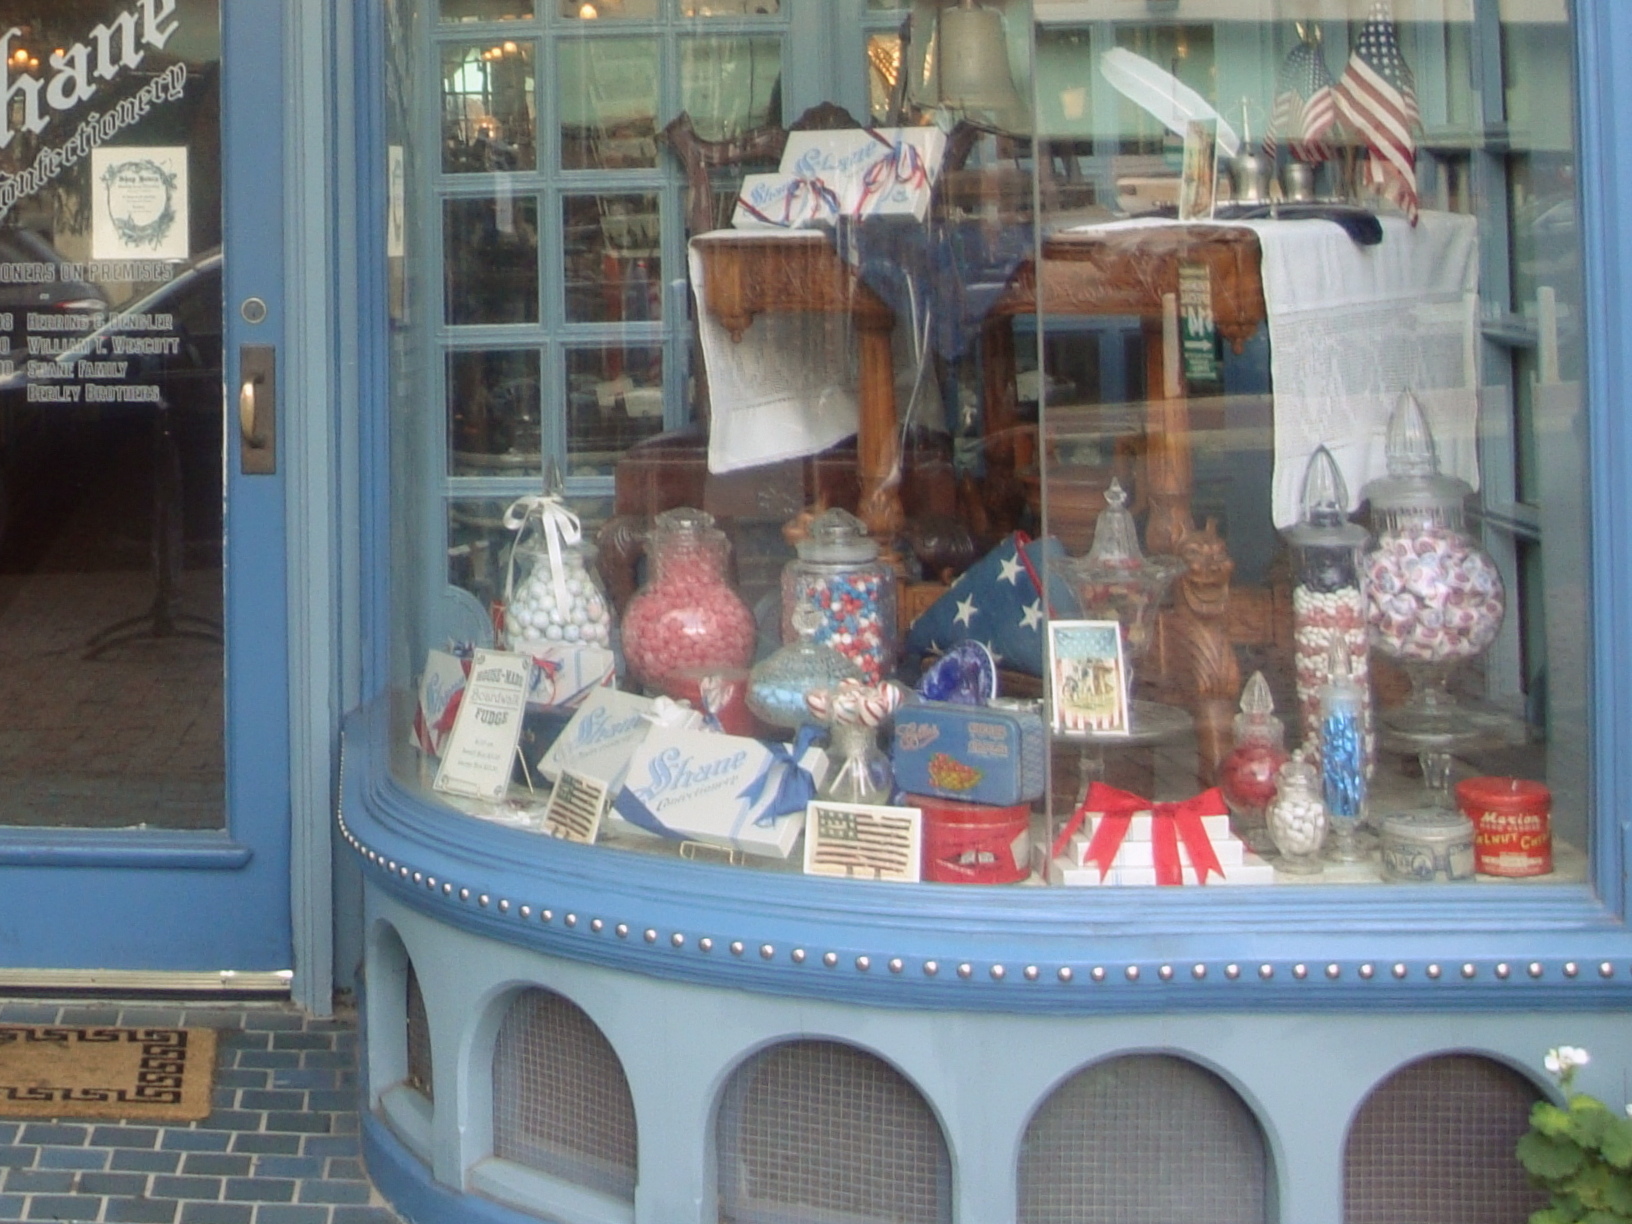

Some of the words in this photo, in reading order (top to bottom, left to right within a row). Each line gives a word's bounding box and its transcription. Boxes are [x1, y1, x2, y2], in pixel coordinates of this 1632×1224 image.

[60, 262, 84, 283] ON
[89, 261, 175, 283] PREMISES
[27, 360, 76, 379] SHANE
[78, 360, 129, 379] FAMILY
[85, 383, 160, 403] BROTHERS
[474, 707, 509, 726] FUDGE
[635, 747, 747, 804] Shane
